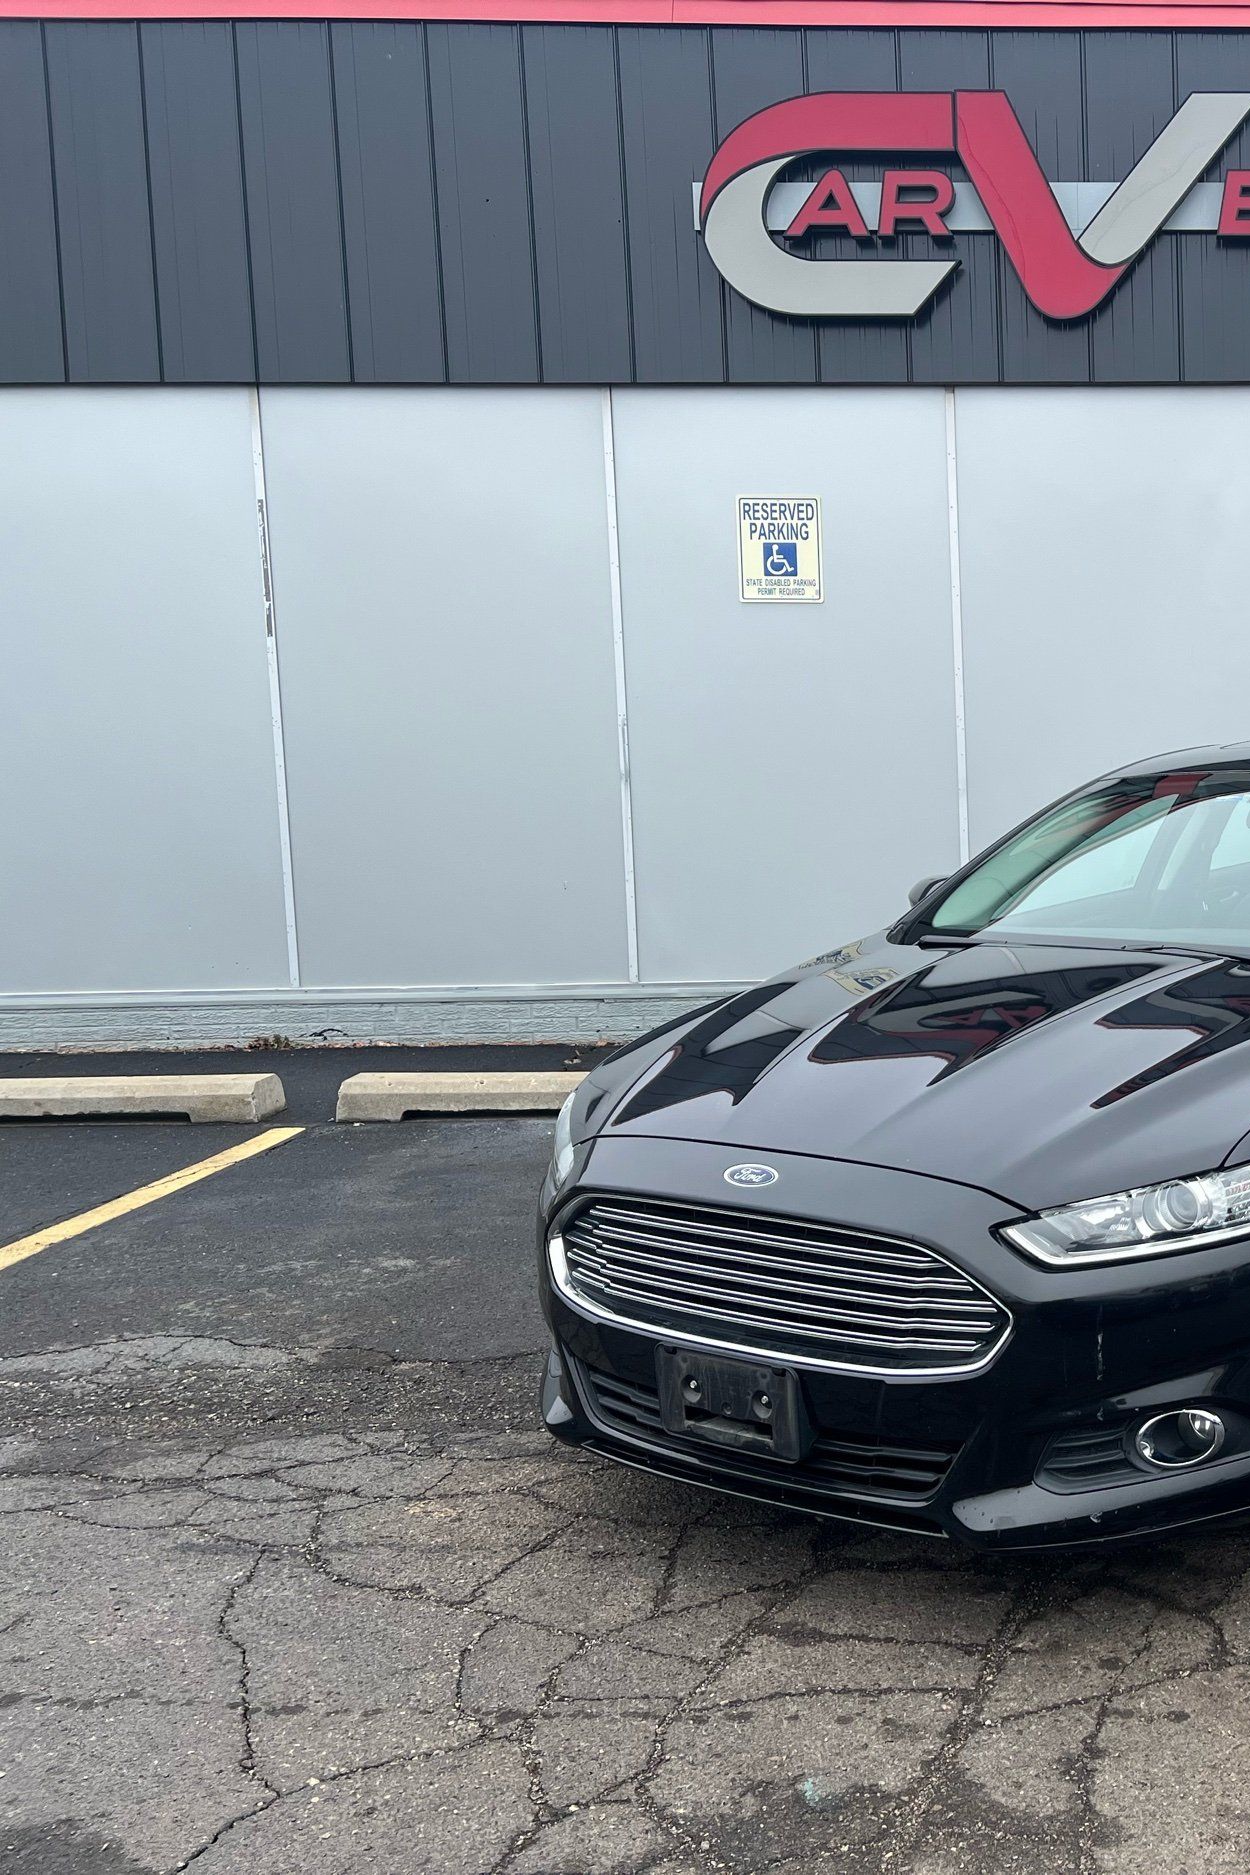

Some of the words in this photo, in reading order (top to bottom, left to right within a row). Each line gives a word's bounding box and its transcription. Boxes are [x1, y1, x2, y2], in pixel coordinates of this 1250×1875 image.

[743, 502, 815, 521] RESERVED
[749, 522, 810, 541] PARKING
[746, 578, 763, 587] STATE
[765, 579, 791, 587] DISABLED
[793, 579, 817, 587] PARKING
[757, 587, 776, 596] PERMIT
[779, 588, 806, 596] REQUIRED
[733, 1167, 767, 1183] Ford
